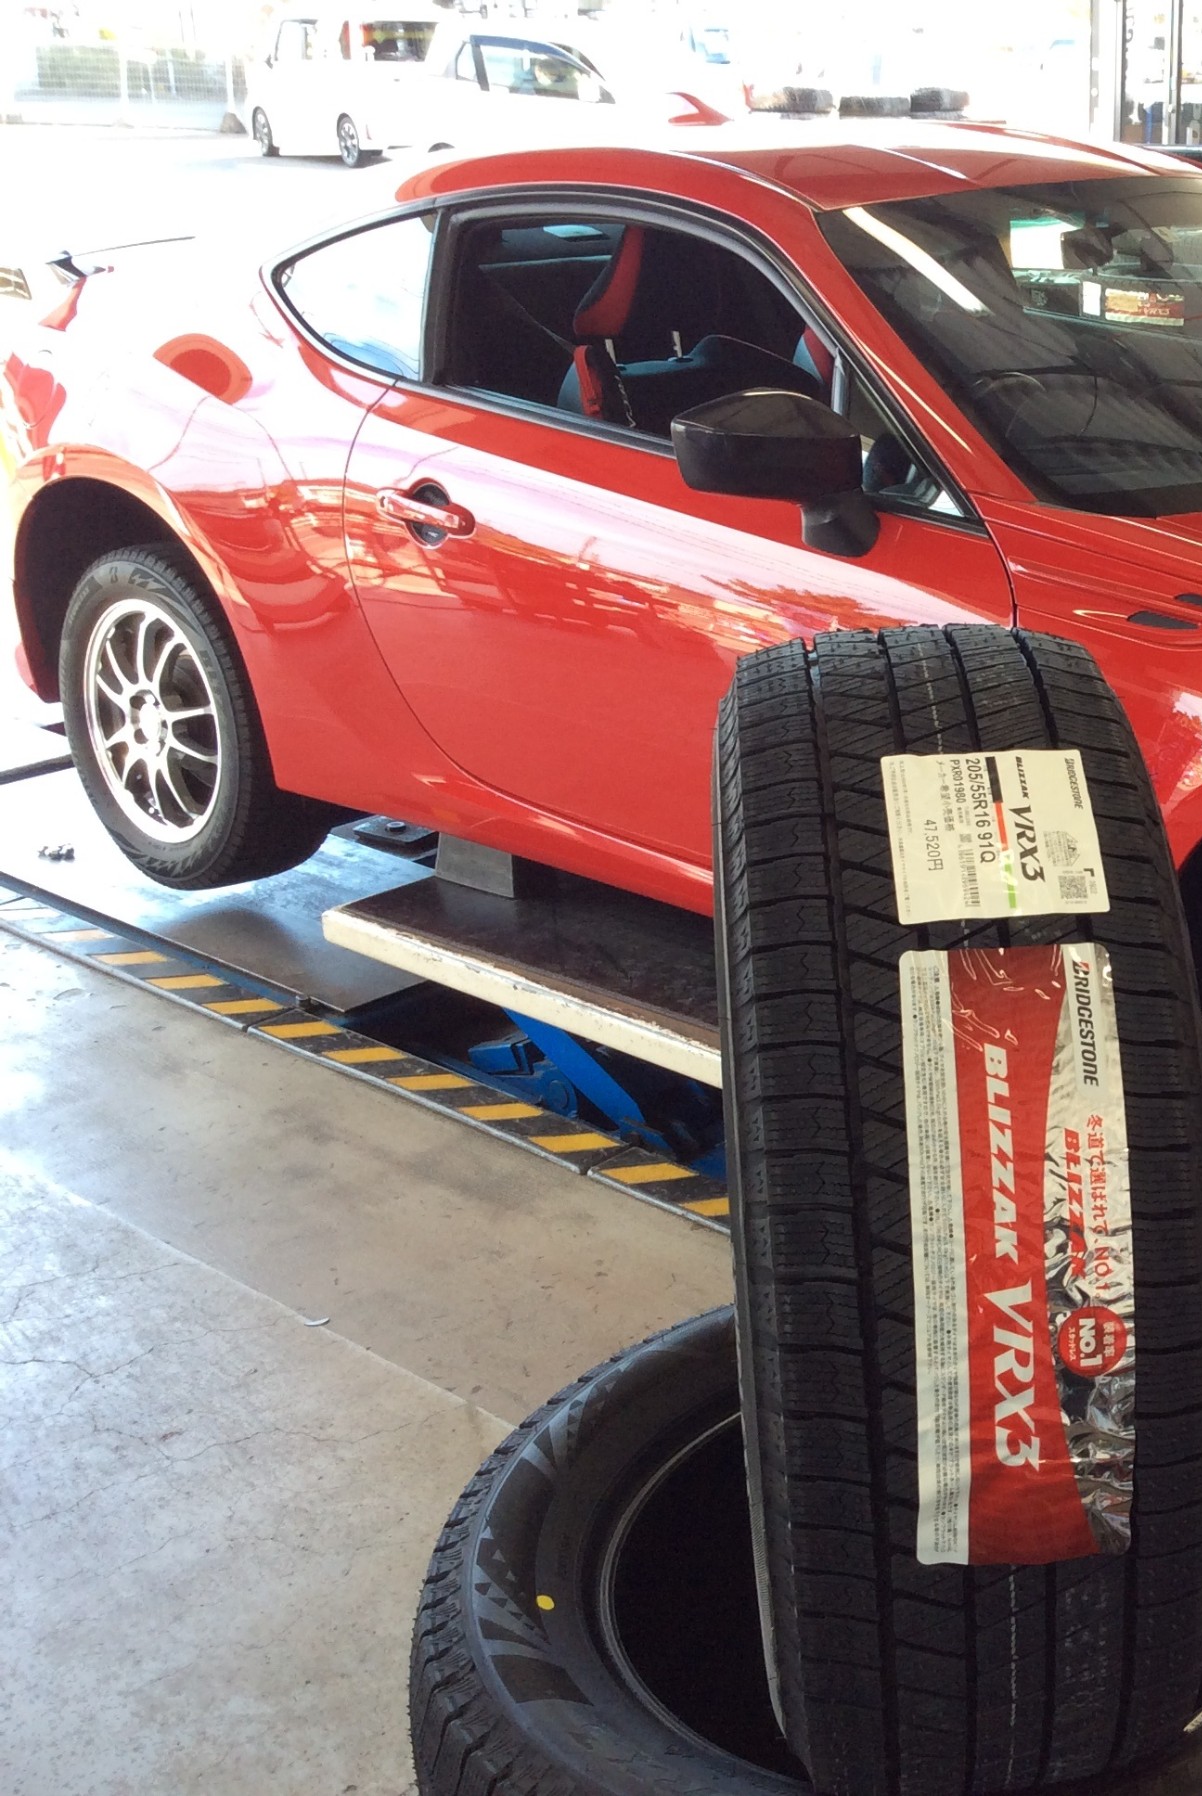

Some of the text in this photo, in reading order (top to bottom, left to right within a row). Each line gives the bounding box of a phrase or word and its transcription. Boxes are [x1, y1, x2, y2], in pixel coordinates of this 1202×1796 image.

[949, 759, 966, 804] PXR01980
[965, 758, 990, 828] 205/55R16
[1064, 757, 1084, 809] BRIDGESTONE
[923, 819, 944, 871] 47,520円
[1008, 755, 1046, 883] BLIZZAK VRX3
[976, 832, 996, 864] 91Q
[1072, 959, 1099, 1086] BRIDGESTONE
[1062, 1127, 1087, 1281] BLIZZAK
[982, 1042, 1040, 1472] BLIZZAK VRX3
[1078, 1317, 1103, 1367] NO.1
[1103, 1321, 1115, 1358] 装着率
